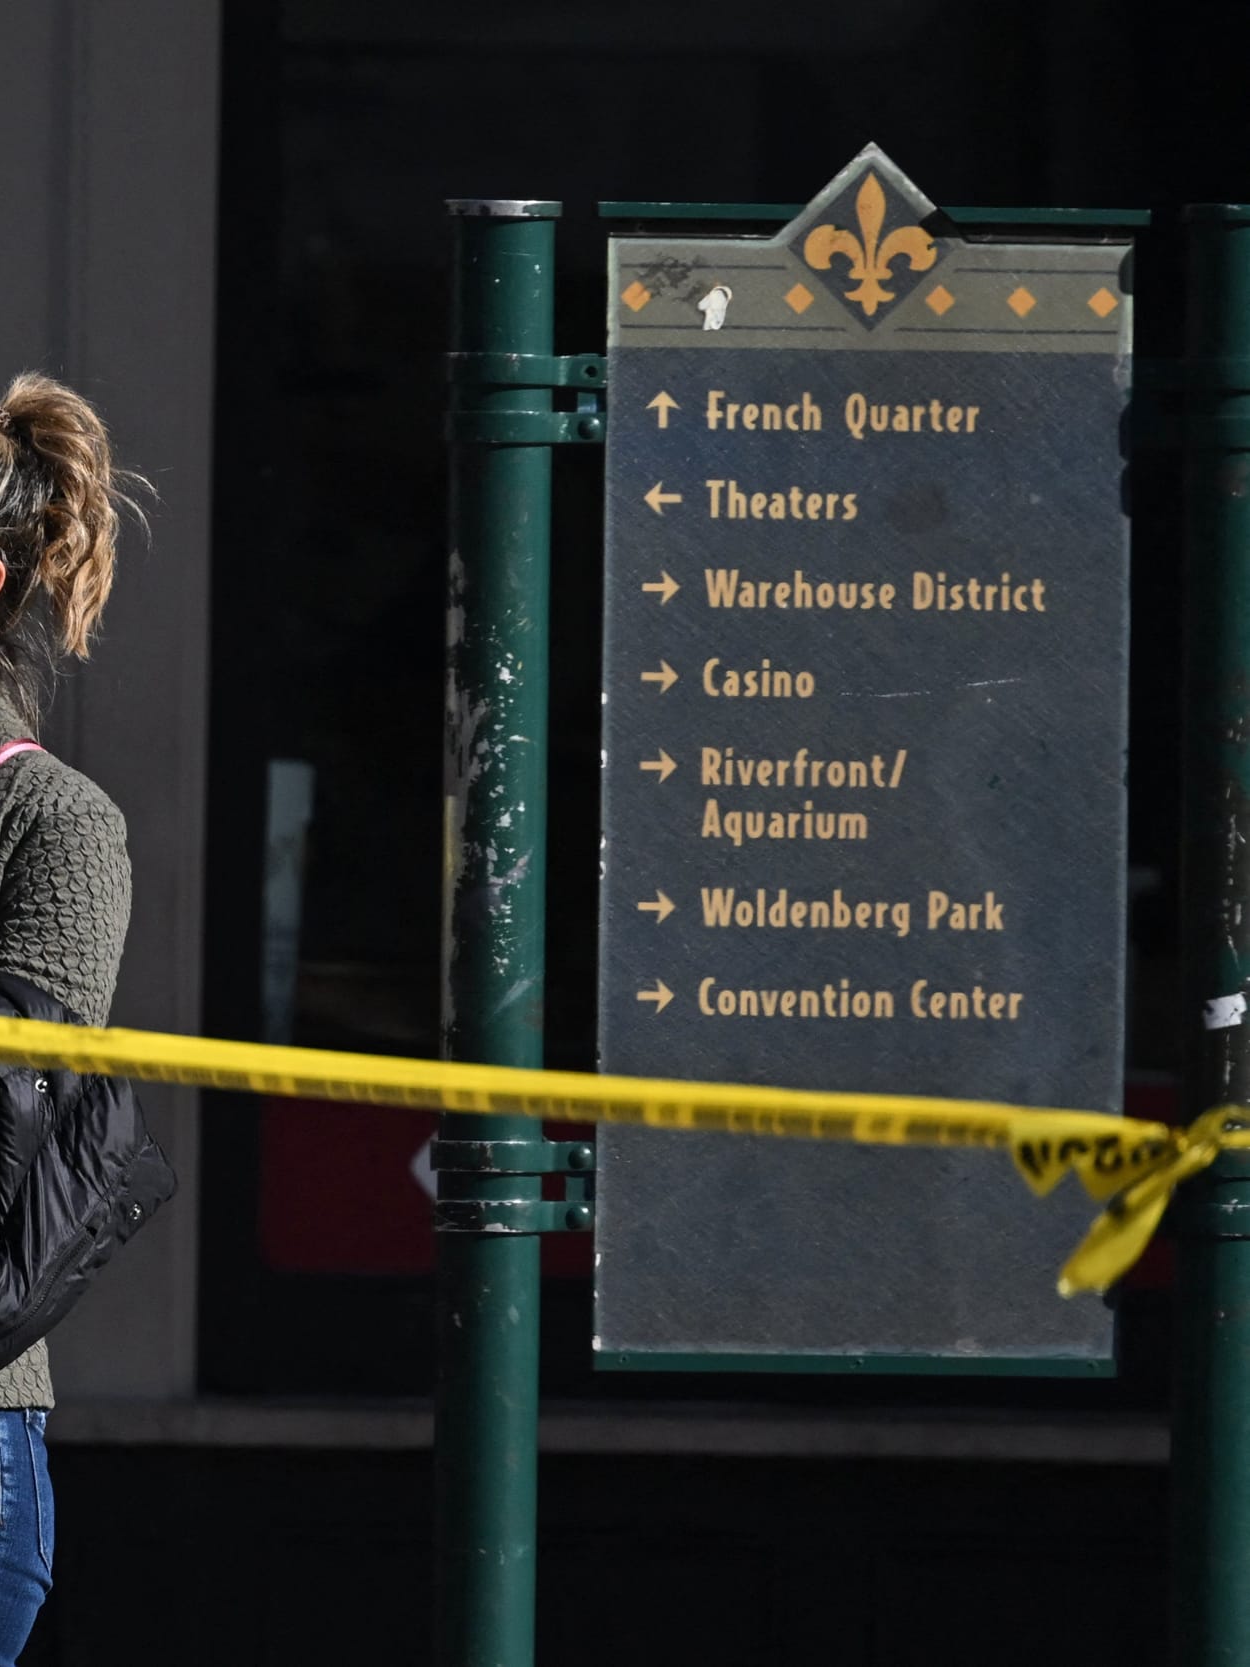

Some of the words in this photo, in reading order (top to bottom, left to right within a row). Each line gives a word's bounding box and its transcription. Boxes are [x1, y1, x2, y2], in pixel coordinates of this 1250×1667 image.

[705, 391, 822, 431] French
[845, 393, 980, 440] Quarter
[706, 480, 858, 520] Theaters
[705, 569, 896, 609] Warehouse
[913, 572, 1046, 612] District
[702, 658, 816, 697] Casino
[701, 747, 908, 788] Riverfront/
[702, 799, 868, 846] Aquarium
[701, 888, 911, 937] Woldenberg
[928, 891, 1005, 930] Park
[699, 978, 894, 1018] Convention
[911, 980, 1023, 1020] Center
